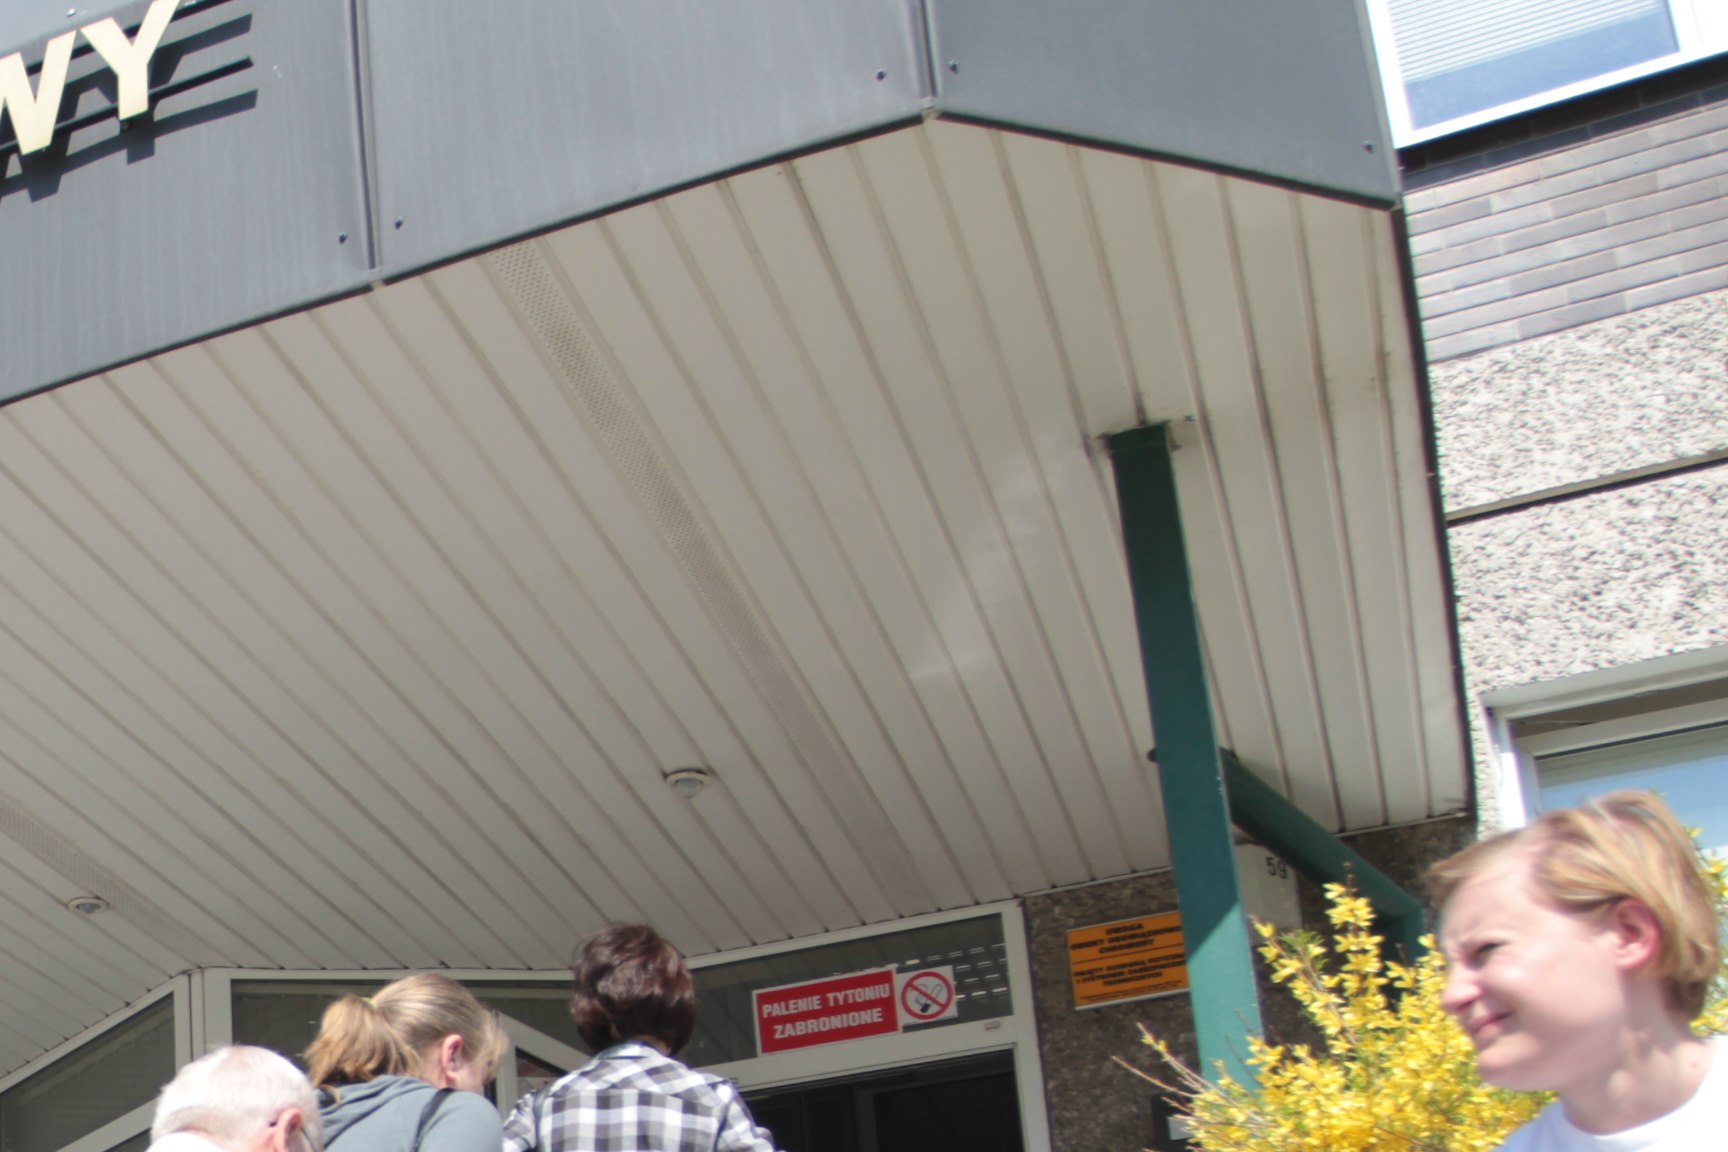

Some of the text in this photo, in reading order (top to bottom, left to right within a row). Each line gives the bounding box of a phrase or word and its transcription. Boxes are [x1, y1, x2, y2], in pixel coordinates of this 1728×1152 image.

[762, 983, 890, 1019] PALENIE TYTONIU
[774, 1008, 883, 1040] ZABRONIONE
